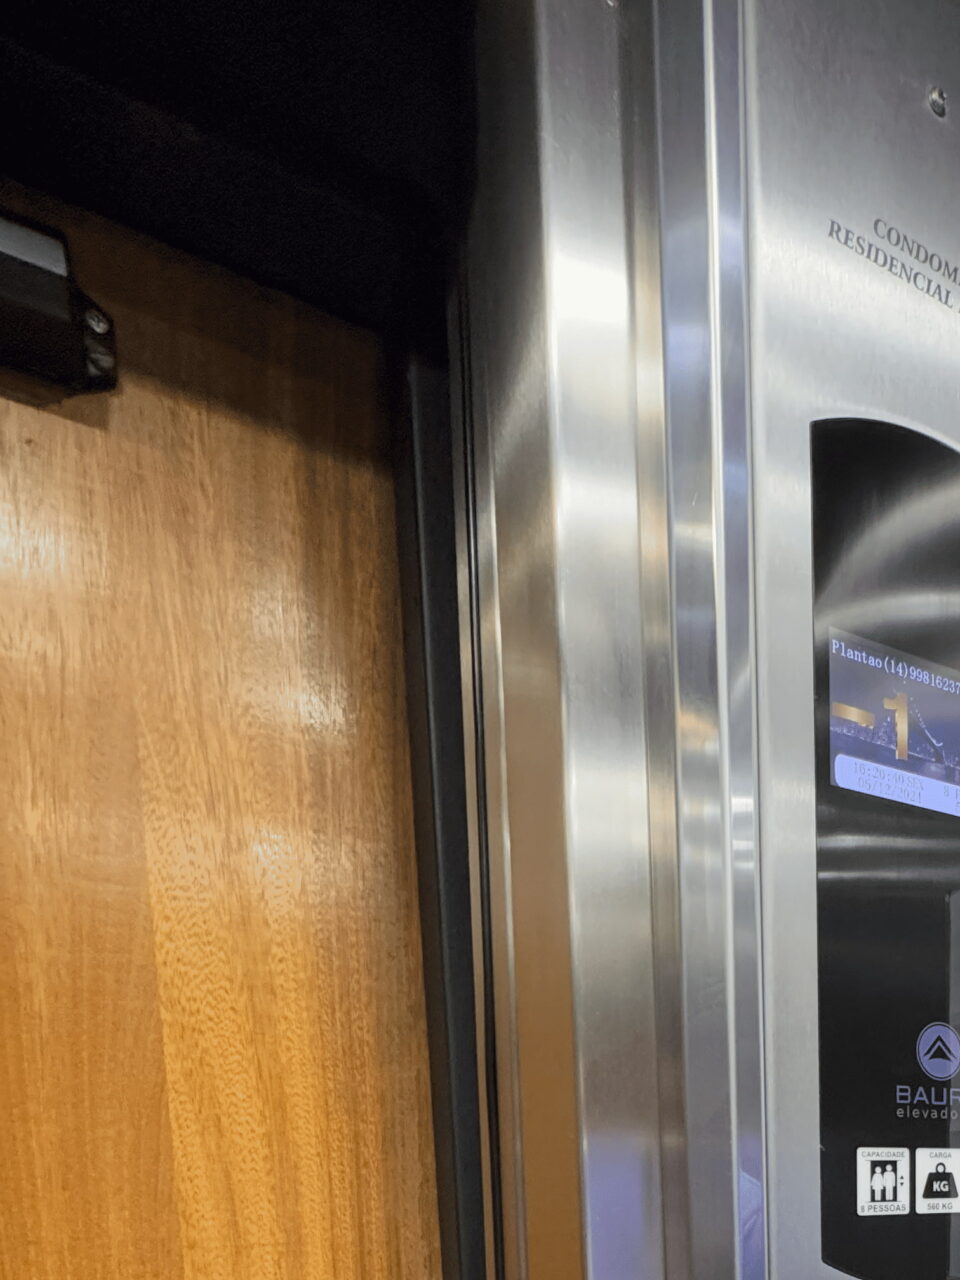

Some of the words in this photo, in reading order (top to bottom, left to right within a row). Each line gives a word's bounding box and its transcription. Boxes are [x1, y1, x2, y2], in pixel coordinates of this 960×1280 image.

[828, 219, 953, 309] RESIDENCIAL
[832, 693, 908, 760] -1
[861, 1150, 906, 1159] CAPACIDADE
[929, 1151, 952, 1159] CARGA
[932, 1181, 950, 1192] KG
[867, 1204, 907, 1213] PESSOAS
[927, 1203, 940, 1211] 560
[941, 1202, 953, 1211] KG
